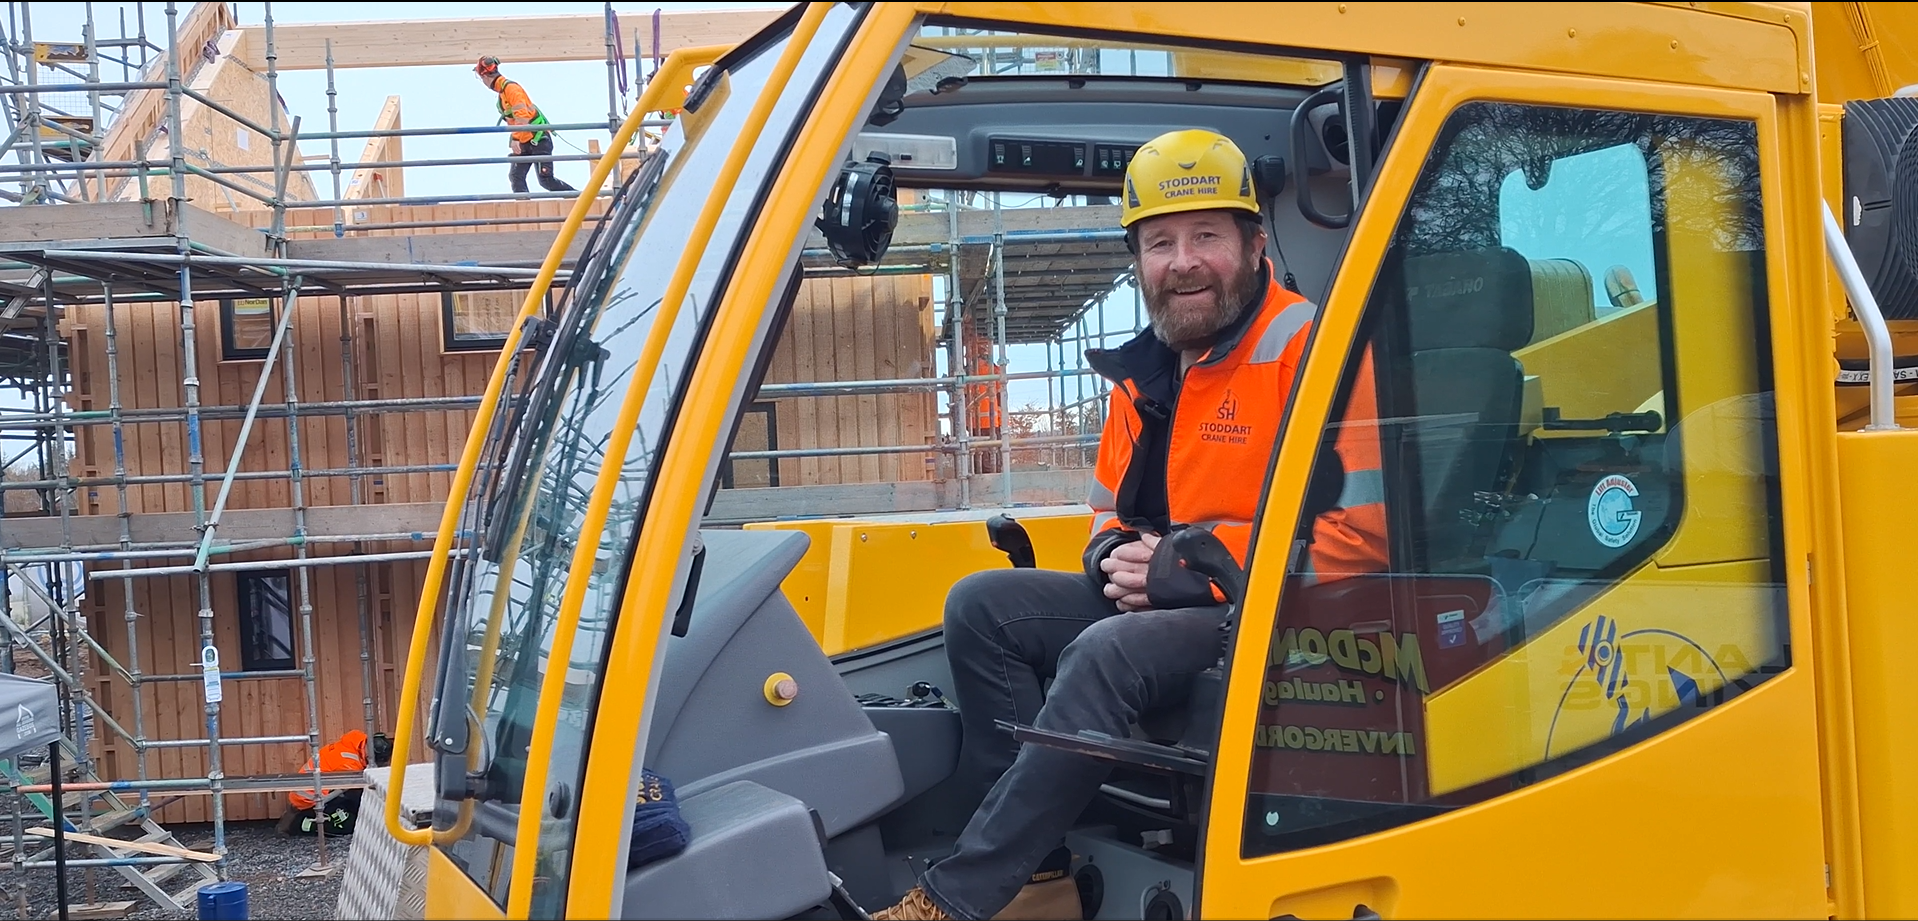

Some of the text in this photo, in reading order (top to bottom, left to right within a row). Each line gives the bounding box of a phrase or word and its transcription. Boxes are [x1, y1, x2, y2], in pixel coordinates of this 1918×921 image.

[1159, 176, 1221, 190] STODDART
[1165, 188, 1194, 198] CRANE
[1199, 422, 1252, 435] STODDART
[1201, 433, 1247, 444] CRANE HIRE
[1606, 477, 1633, 493] Adjuster
